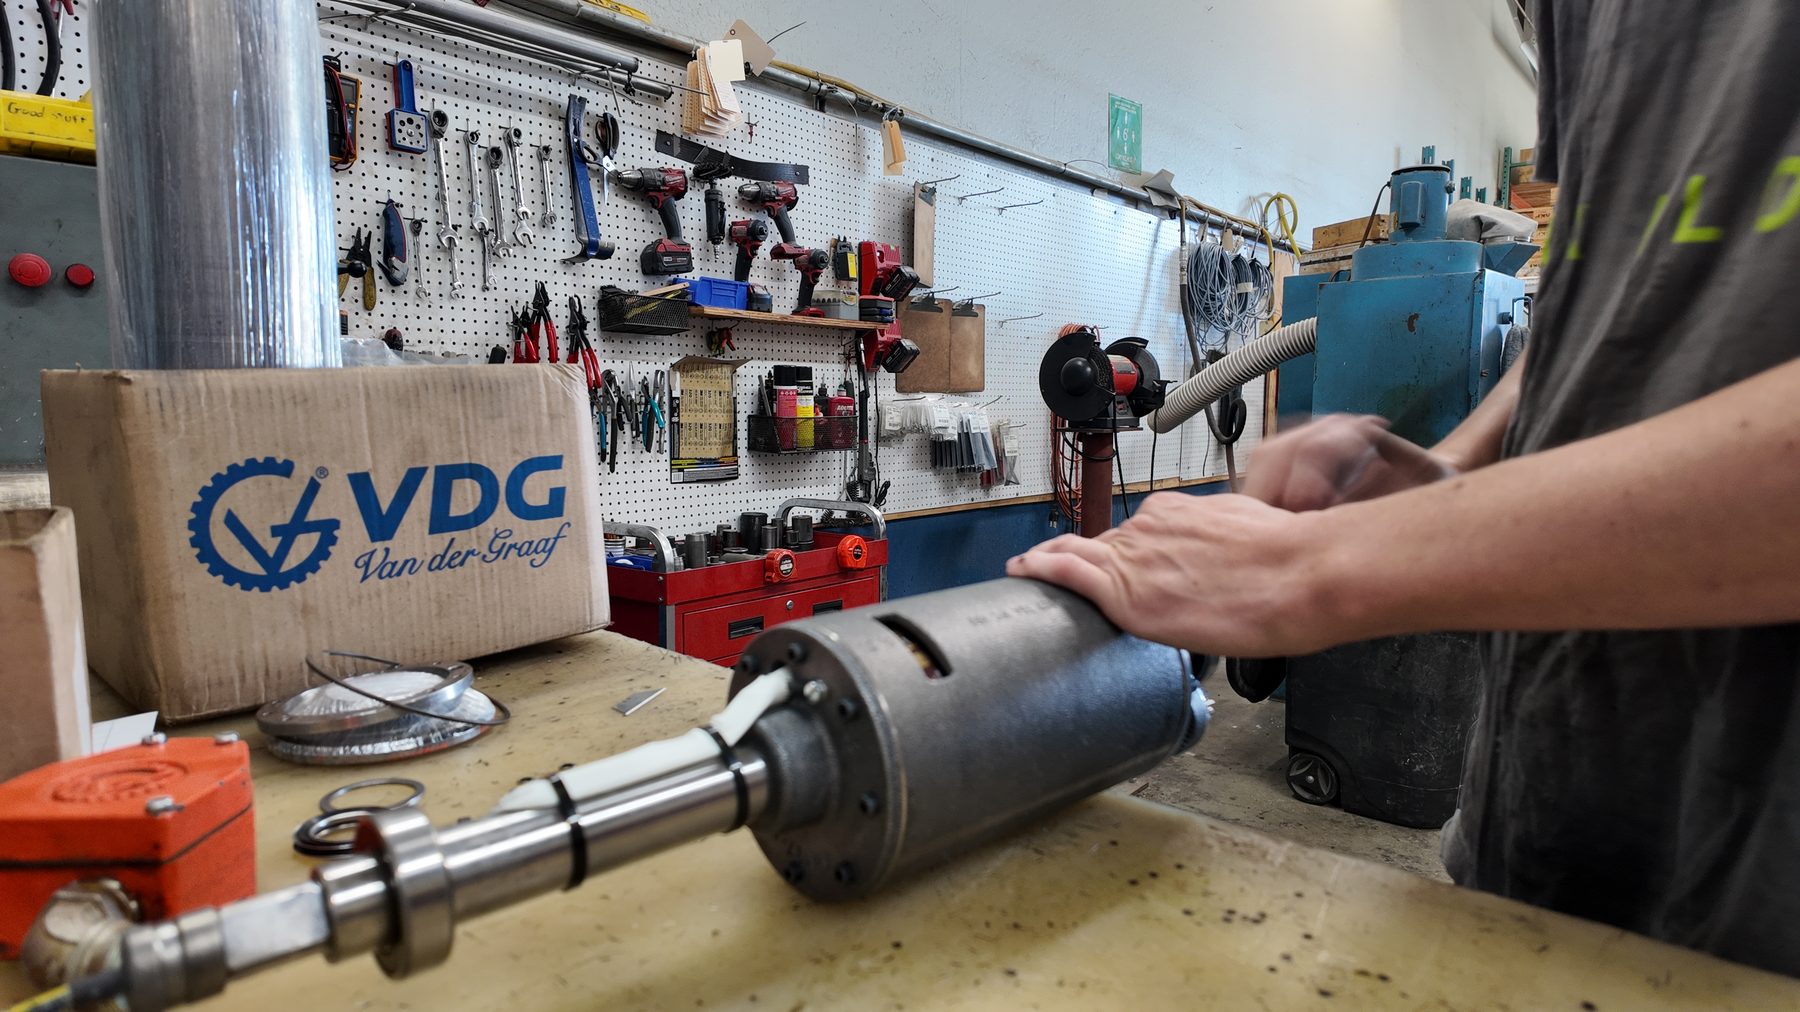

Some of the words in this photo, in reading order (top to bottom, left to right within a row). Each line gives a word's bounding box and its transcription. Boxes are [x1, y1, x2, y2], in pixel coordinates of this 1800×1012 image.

[7, 101, 45, 118] Good
[346, 454, 567, 543] VDG
[354, 547, 425, 584] Van
[427, 537, 482, 572] der
[481, 521, 572, 569] Graaf
